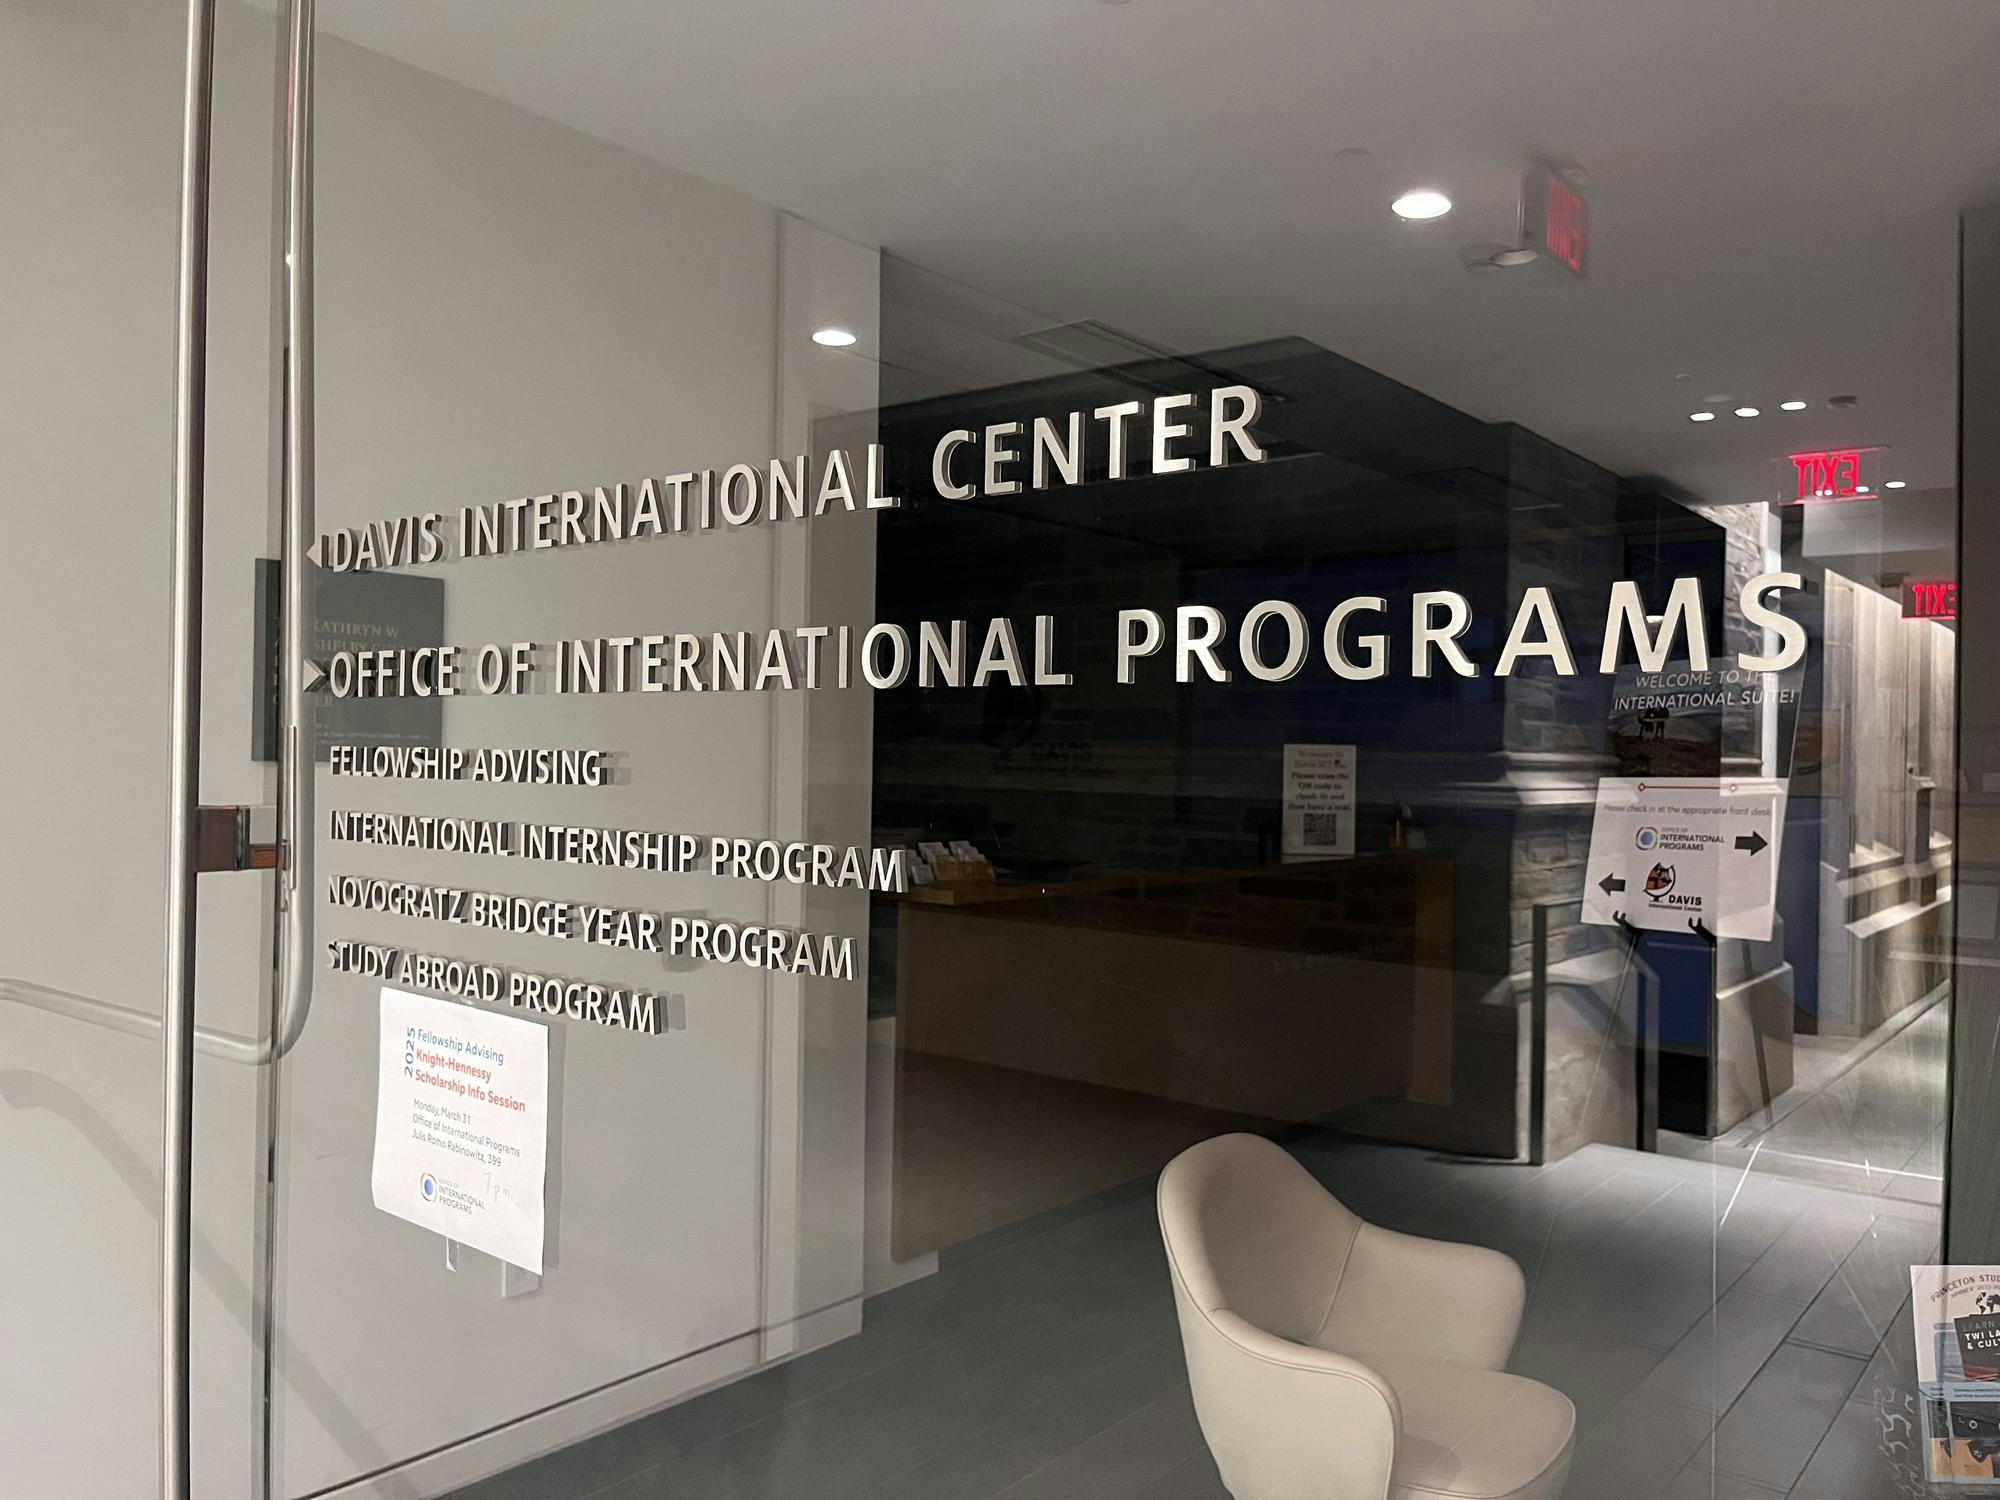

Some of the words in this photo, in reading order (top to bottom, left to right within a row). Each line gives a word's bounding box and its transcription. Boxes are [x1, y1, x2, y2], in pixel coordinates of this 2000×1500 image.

[332, 513, 442, 572] DAVIS
[459, 443, 900, 558] INTERNATIONAL
[932, 385, 1267, 500] CENTER
[330, 646, 460, 698] OFFICE
[476, 641, 540, 695] OF
[556, 615, 1073, 693] INTERNATIONAL
[1116, 571, 1808, 684] PROGRAMS
[1635, 671, 1712, 689] WELCOME
[1718, 670, 1740, 685] TO
[1614, 692, 1735, 711] INTERNATIONAL
[329, 745, 467, 780] FELLOWSHIP
[471, 748, 605, 786] ADVISING
[1627, 803, 1647, 813] check
[1657, 805, 1666, 814] at
[1667, 805, 1681, 814] the
[1681, 806, 1727, 816] appropriate
[1729, 806, 1749, 815] front
[329, 810, 513, 856] INTERNATIONAL
[520, 823, 699, 873] INTERNSHIP
[711, 836, 907, 893] PROGRAM
[1659, 842, 1704, 851] PROGRAMS
[1660, 833, 1725, 844] INTERNATIONAL
[1668, 894, 1702, 906] DAVIS
[327, 874, 467, 924] NOVOGRATZ
[471, 891, 573, 939] BRIDGE
[579, 903, 663, 953] YEAR
[670, 916, 859, 981] PROGRAM
[326, 940, 397, 980] STUDY
[399, 951, 504, 1001] ABROAD
[509, 970, 661, 1035] PROGRAM
[404, 1026, 416, 1079] 2025
[417, 1028, 463, 1054] Fellowship
[465, 1040, 504, 1066] Advising
[415, 1049, 492, 1085] Knight-Hennessy
[415, 1068, 466, 1097] Scholarship
[467, 1084, 486, 1101] Info
[488, 1090, 526, 1113] Session
[413, 1098, 440, 1117] Monday,
[441, 1106, 462, 1121] March
[462, 1113, 471, 1125] 31
[412, 1113, 432, 1129] Office
[433, 1119, 441, 1131] of
[441, 1122, 485, 1146] International
[485, 1136, 521, 1158] Programs
[487, 1152, 502, 1167] 399
[438, 1186, 486, 1210] INTERNATIONAL
[1930, 1276, 1975, 1302] PRINCETON
[1962, 1320, 1995, 1332] LEARN
[1964, 1331, 1985, 1341] TWI
[1967, 1342, 1974, 1350] &
[1977, 1338, 2000, 1349] CUL
